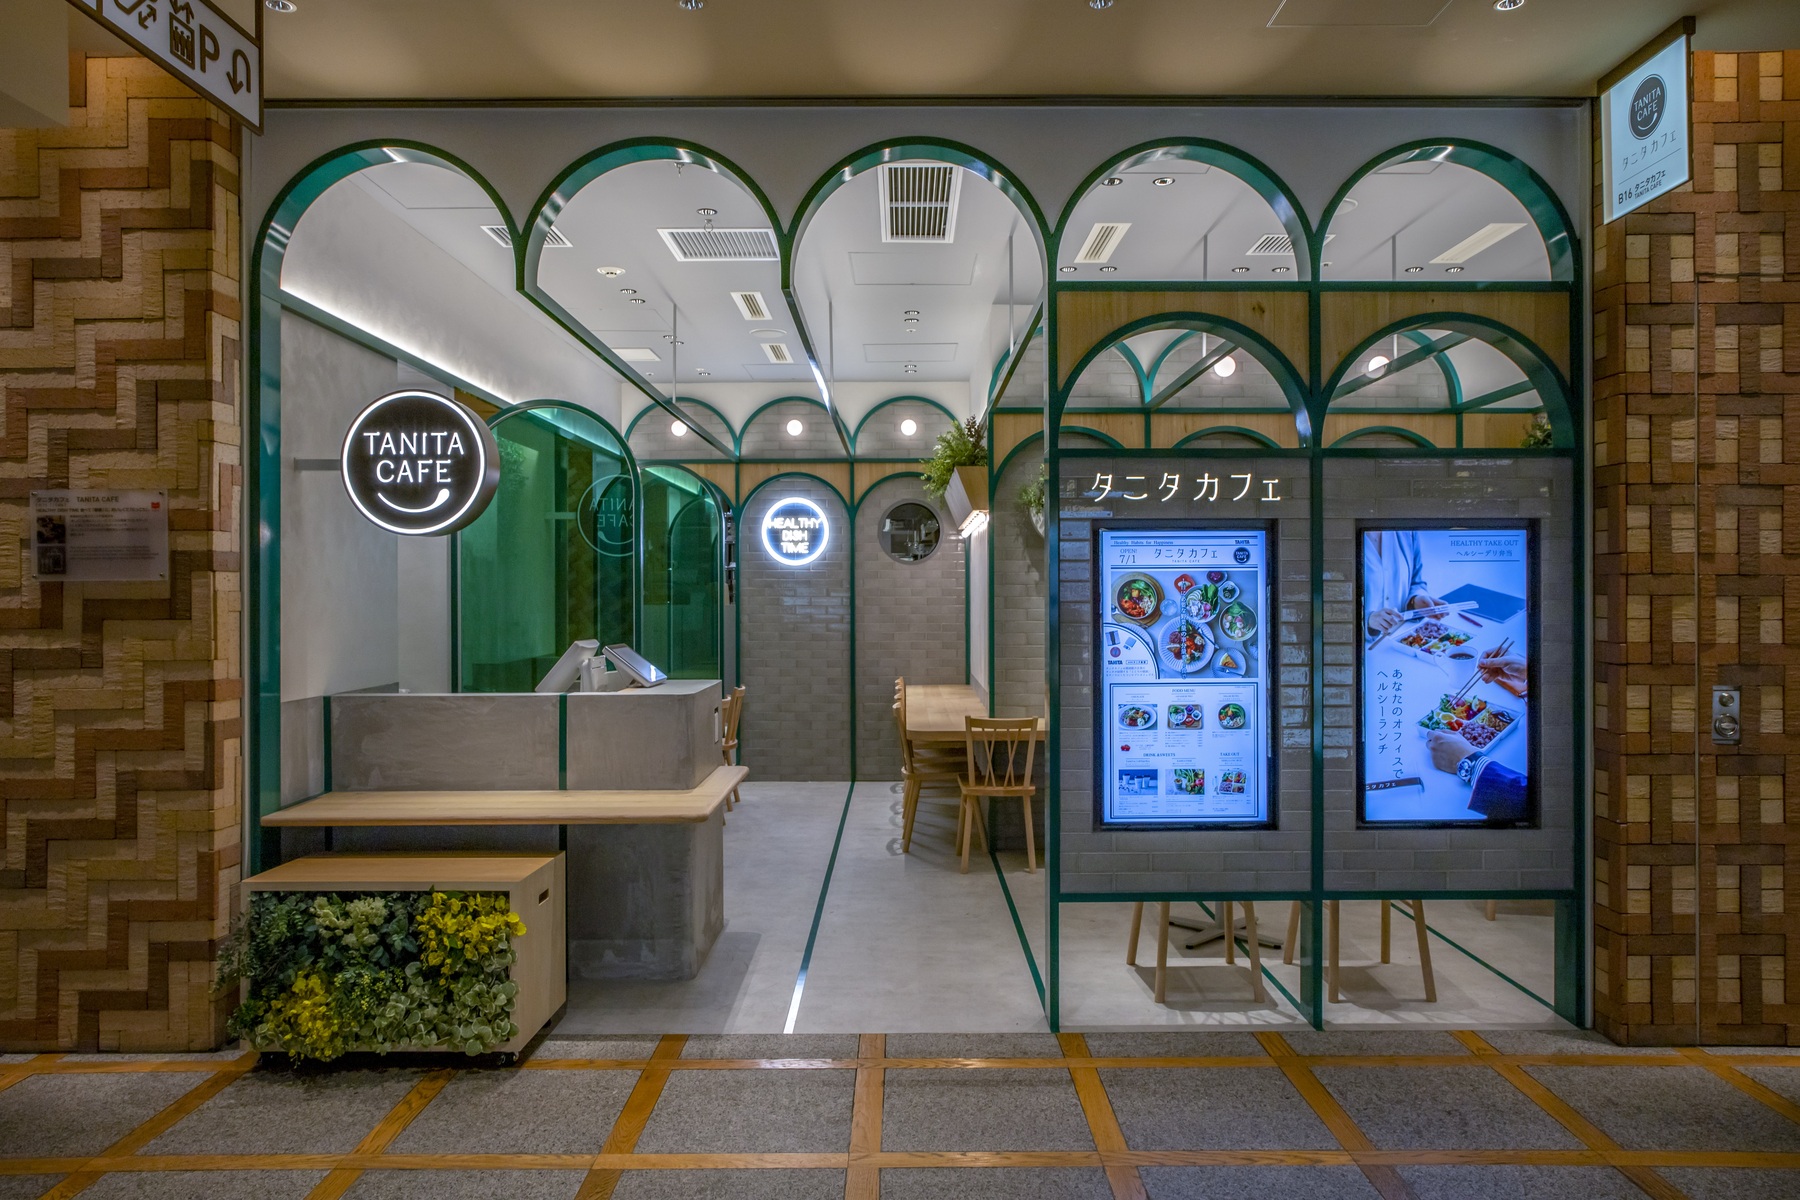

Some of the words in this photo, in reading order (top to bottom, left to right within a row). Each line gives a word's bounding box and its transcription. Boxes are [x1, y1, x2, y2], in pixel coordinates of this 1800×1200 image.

[199, 24, 220, 73] P
[1633, 86, 1662, 112] TANITA
[1636, 99, 1658, 121] CAFE
[1622, 130, 1677, 171] タニタカフェ
[1634, 169, 1666, 193] タニタカフェ
[1634, 187, 1649, 199] TANITA
[1650, 179, 1662, 191] CAFE
[1618, 188, 1632, 205] B16
[363, 431, 464, 455] TANITA
[376, 459, 451, 483] CAFE
[1092, 472, 1281, 502] タニタカフェ
[768, 517, 822, 529] HEALTHY
[782, 529, 808, 542] DISH
[781, 541, 809, 554] TIME
[1119, 554, 1136, 564] 7/1
[1154, 548, 1218, 559] タニタカフェ
[1456, 549, 1513, 557] ヘルシーデリ弁当
[1376, 670, 1388, 755] ヘルシーランチ
[1391, 668, 1403, 779] あなたのオフィスで
